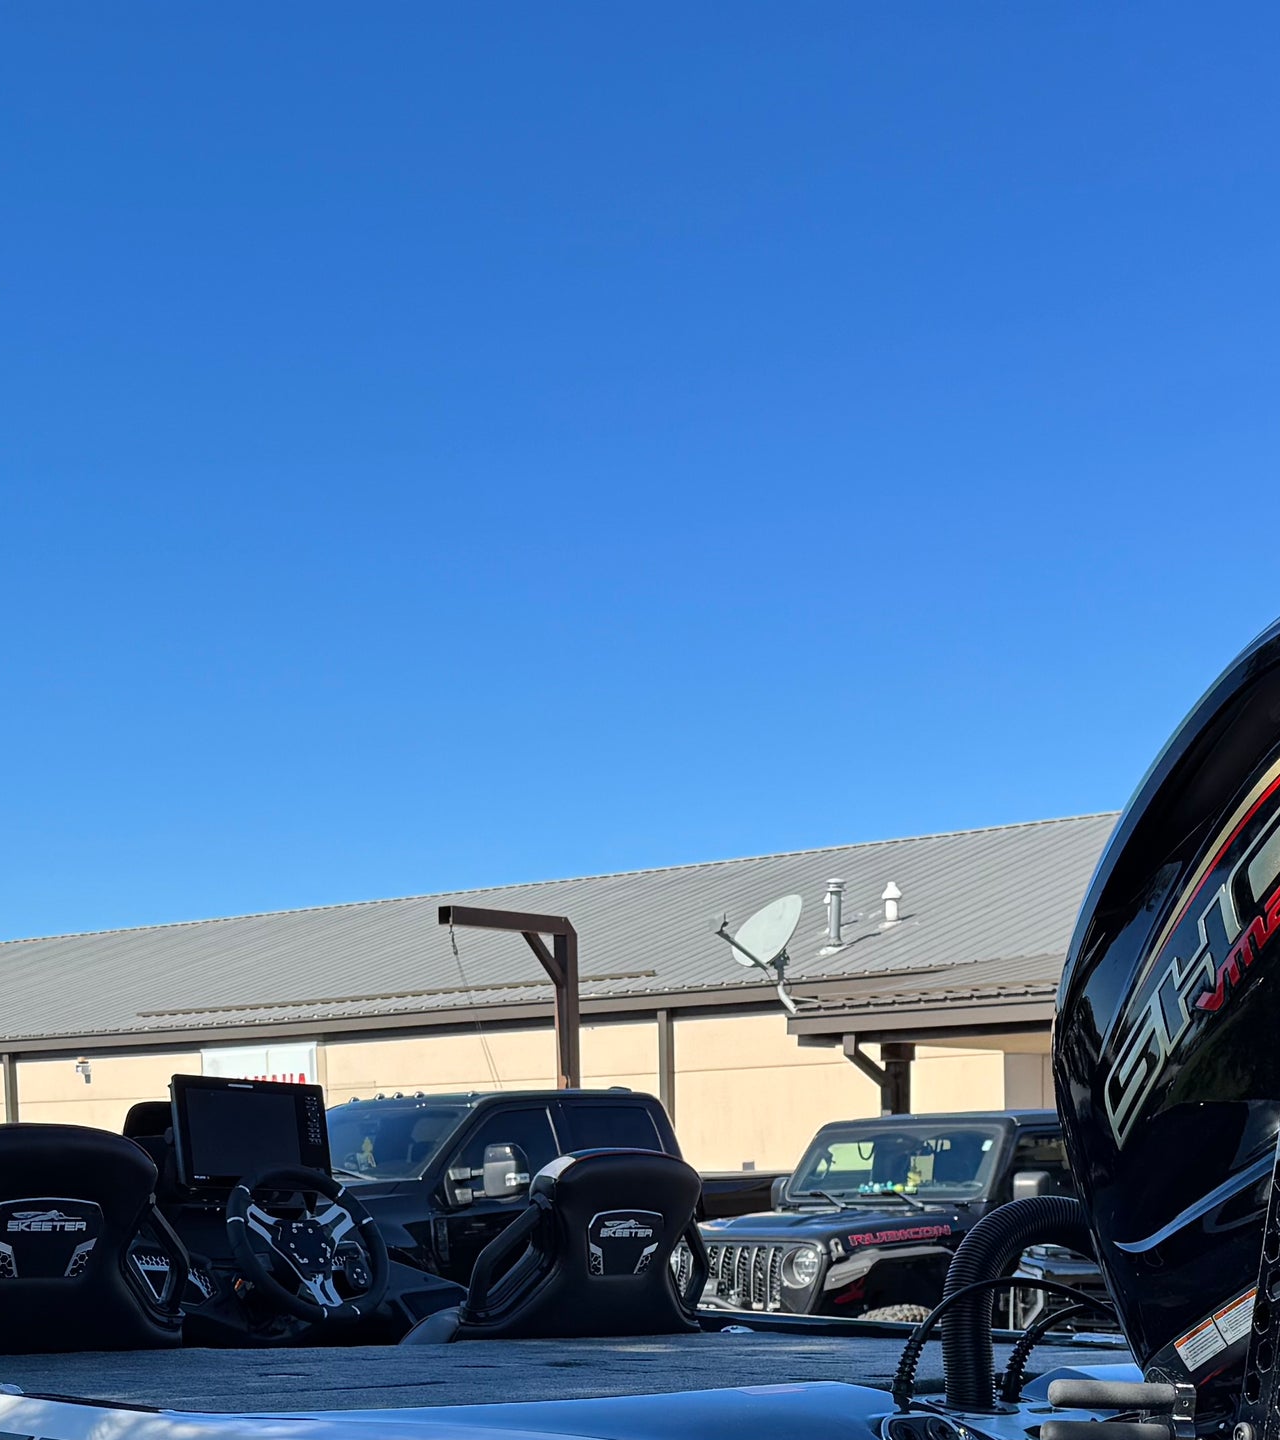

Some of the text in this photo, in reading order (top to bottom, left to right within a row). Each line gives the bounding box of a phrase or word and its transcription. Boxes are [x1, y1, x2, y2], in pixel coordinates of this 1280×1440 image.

[6, 1220, 87, 1232] SKEETER
[600, 1227, 653, 1238] SKEETER
[848, 1224, 952, 1246] RUBICON
